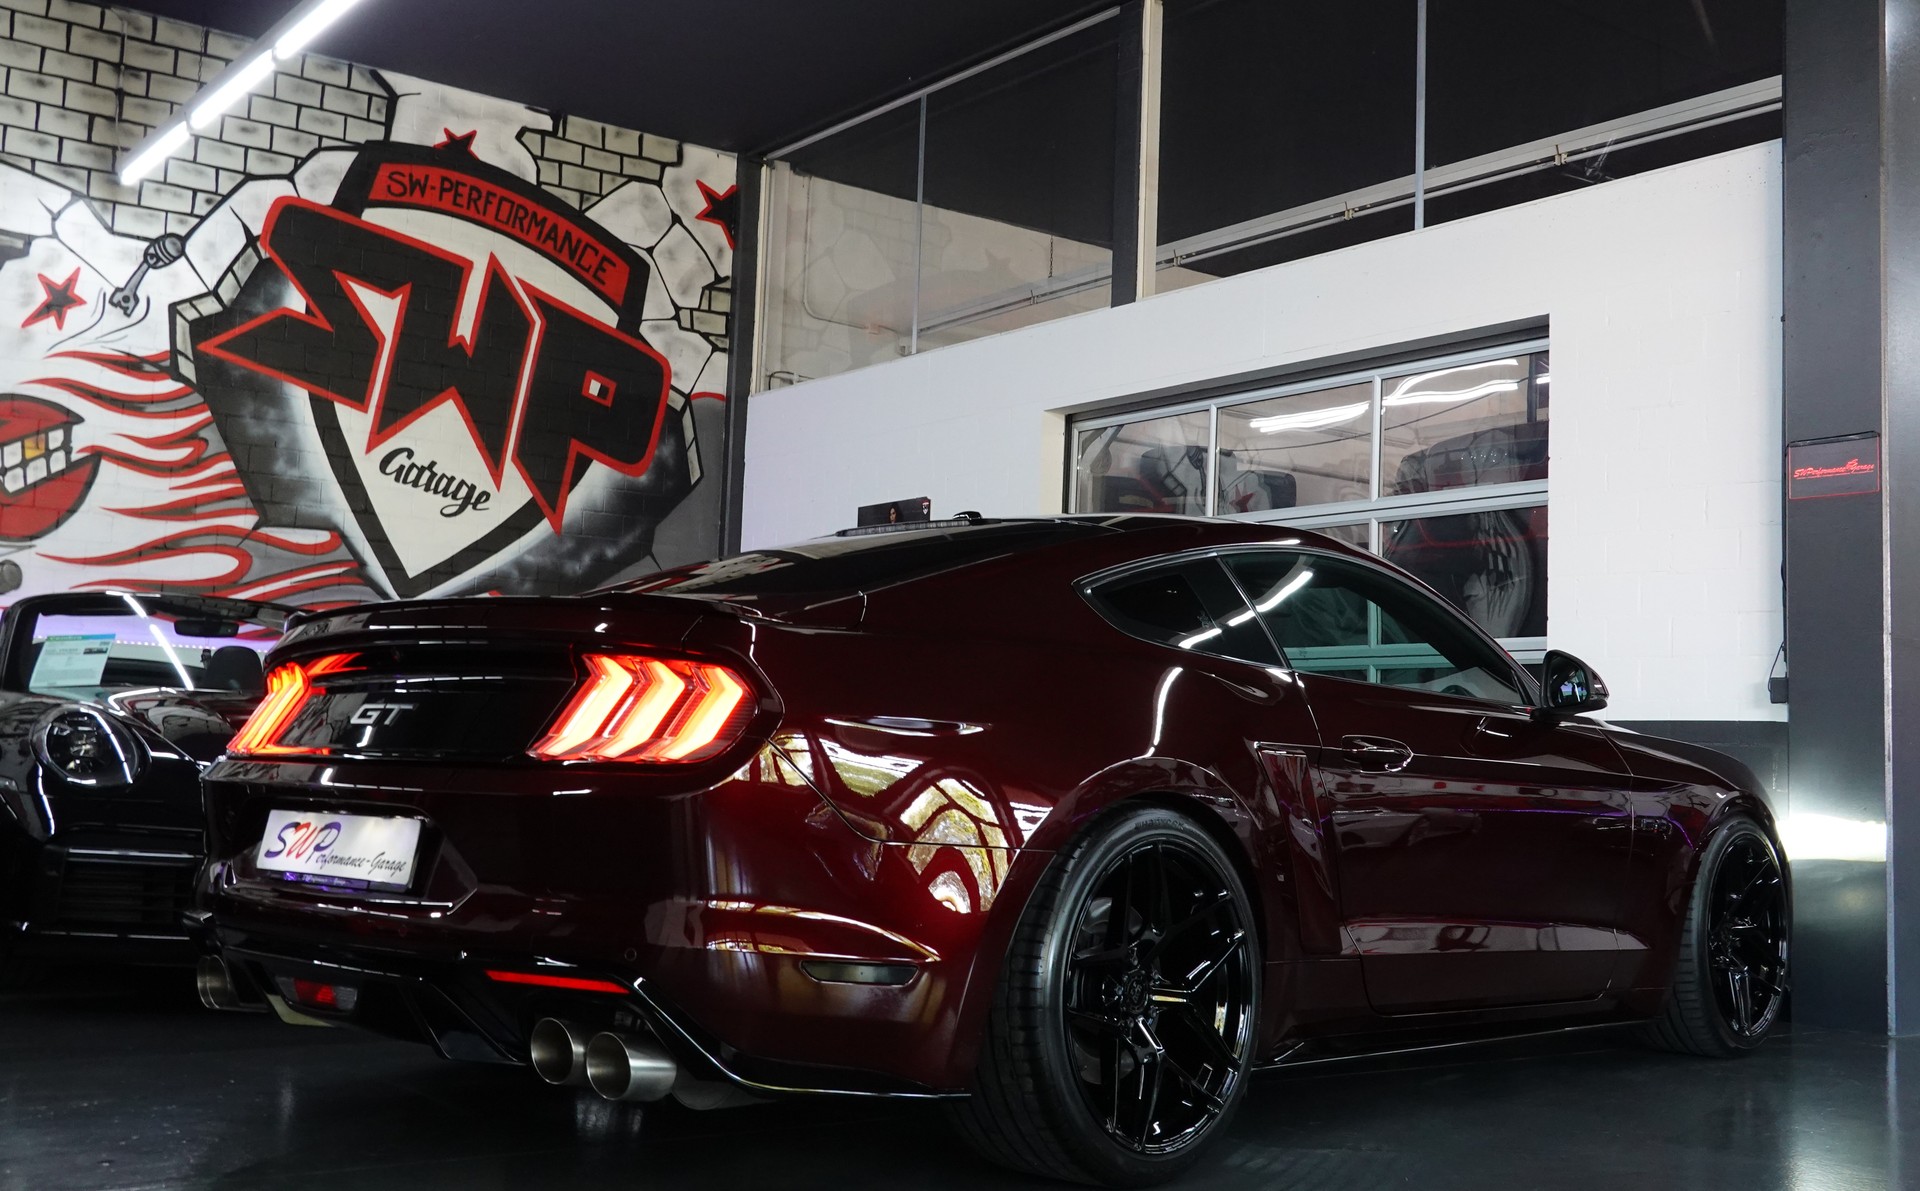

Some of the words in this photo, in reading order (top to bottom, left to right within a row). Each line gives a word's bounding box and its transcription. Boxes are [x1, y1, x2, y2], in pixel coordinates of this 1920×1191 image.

[386, 170, 617, 287] SW-PERFORMANCE
[196, 196, 672, 536] SWP
[379, 447, 491, 517] Garage
[351, 702, 414, 725] GT
